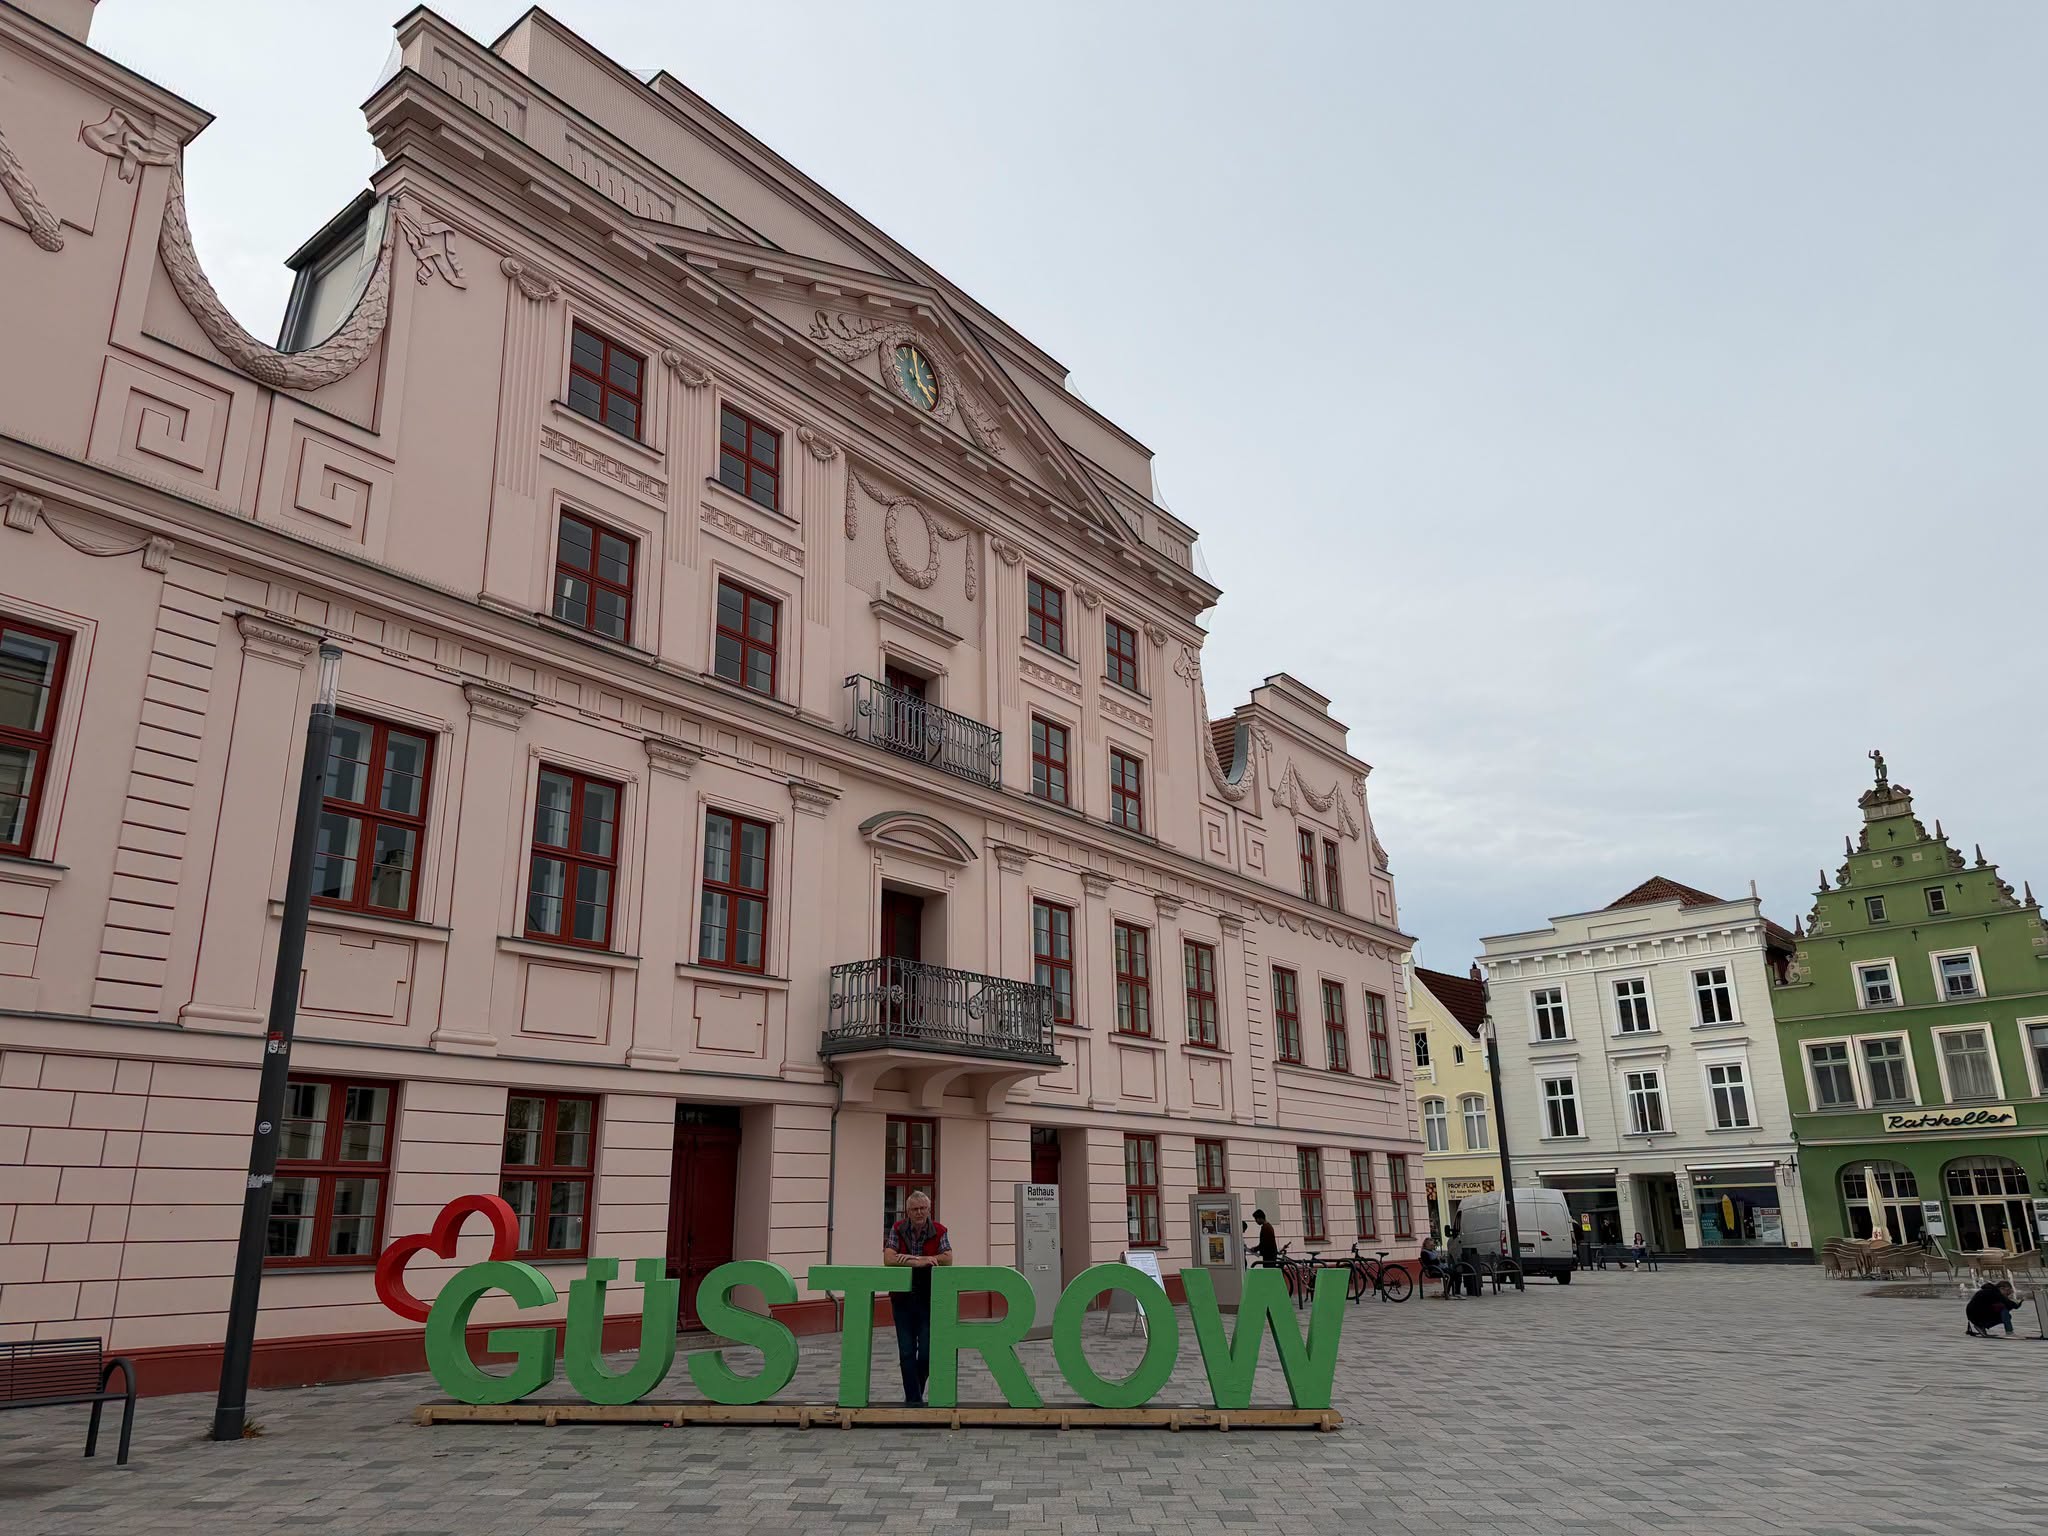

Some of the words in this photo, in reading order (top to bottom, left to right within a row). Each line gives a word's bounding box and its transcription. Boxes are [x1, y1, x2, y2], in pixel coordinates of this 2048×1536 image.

[1888, 1110, 2013, 1129] Ratskeller
[1027, 1186, 1055, 1197] Rathaus
[425, 1256, 1347, 1410] GÜSTROW
